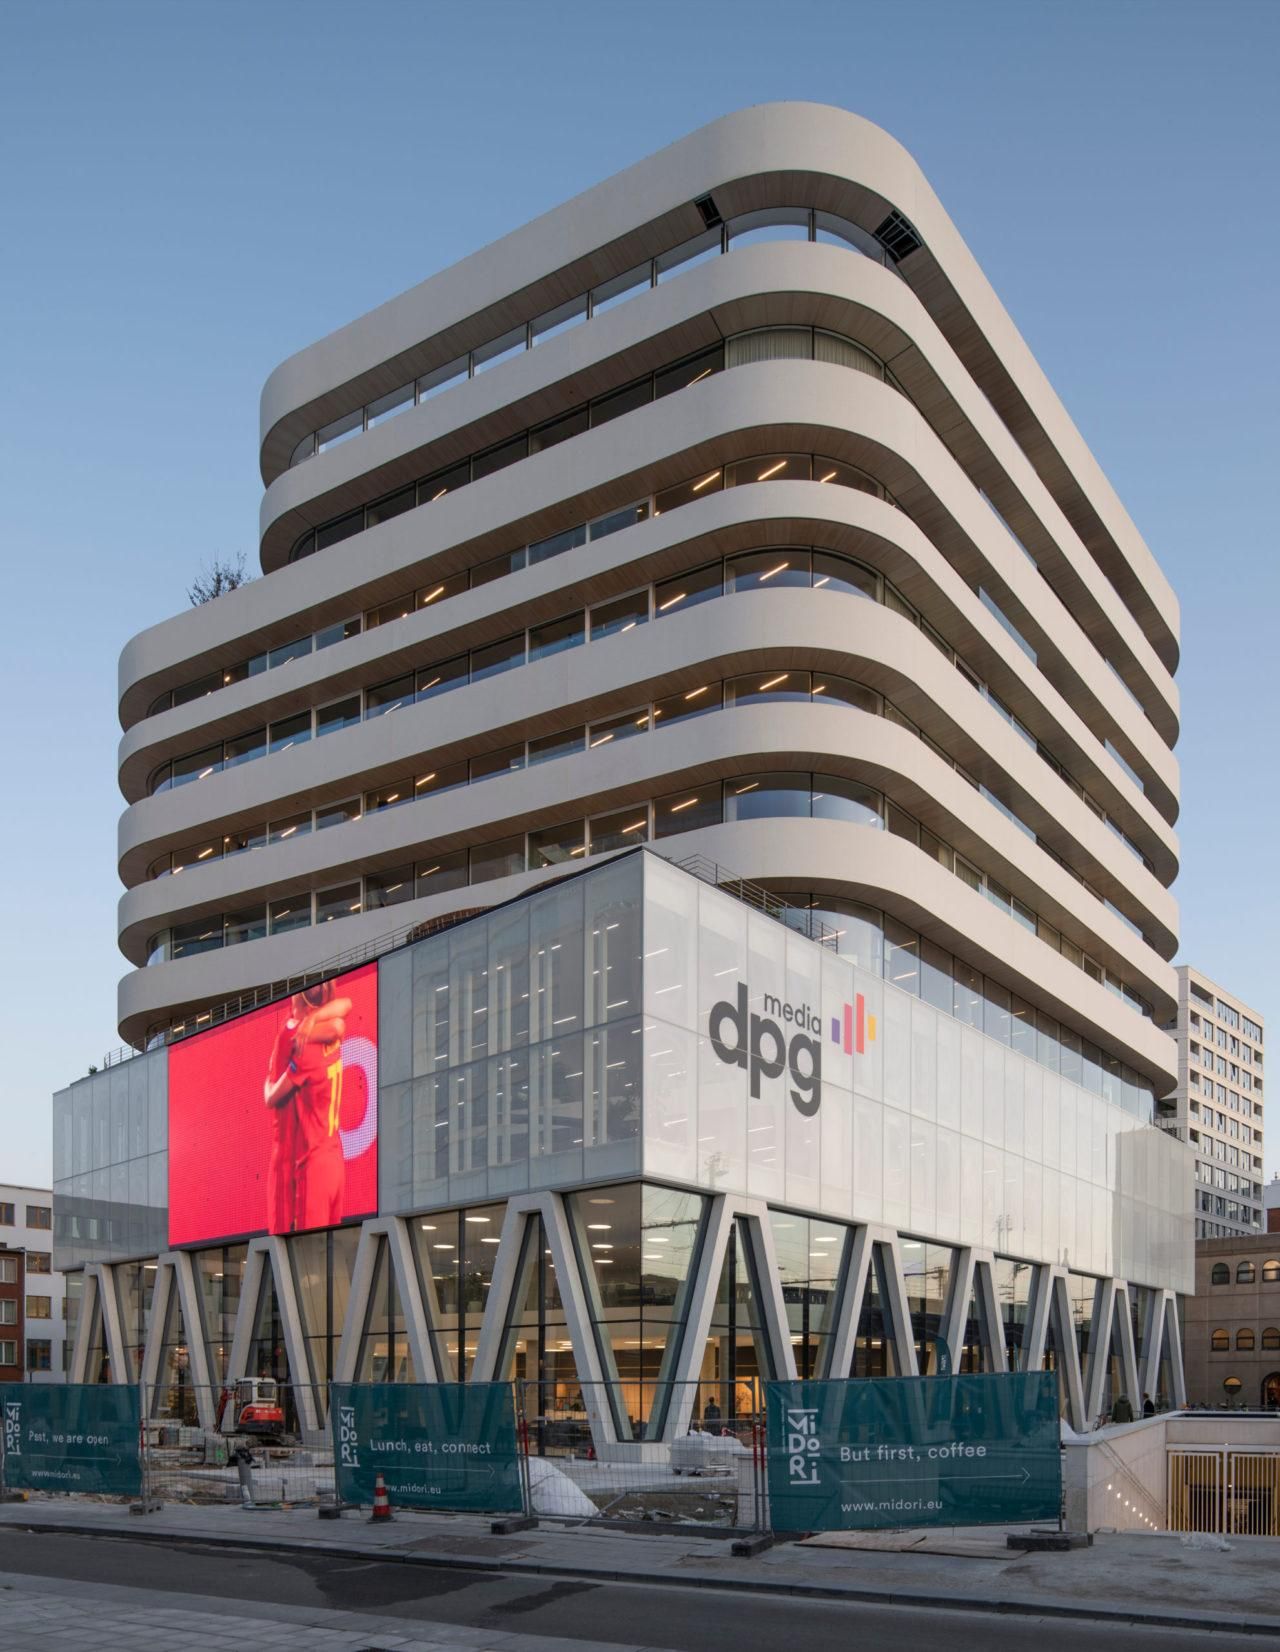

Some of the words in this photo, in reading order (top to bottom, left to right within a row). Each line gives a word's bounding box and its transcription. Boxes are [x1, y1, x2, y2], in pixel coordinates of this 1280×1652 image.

[764, 992, 822, 1037] media
[709, 981, 822, 1117] dpg
[52, 1434, 64, 1443] we
[66, 1434, 83, 1444] are
[86, 1435, 109, 1446] open
[370, 1439, 411, 1454] Lunch,
[415, 1441, 438, 1455] eat,
[442, 1442, 491, 1454] connect
[840, 1446, 870, 1462] But
[876, 1445, 921, 1463] first,
[928, 1442, 987, 1460] coffee
[841, 1499, 943, 1513] www.midori.eu
